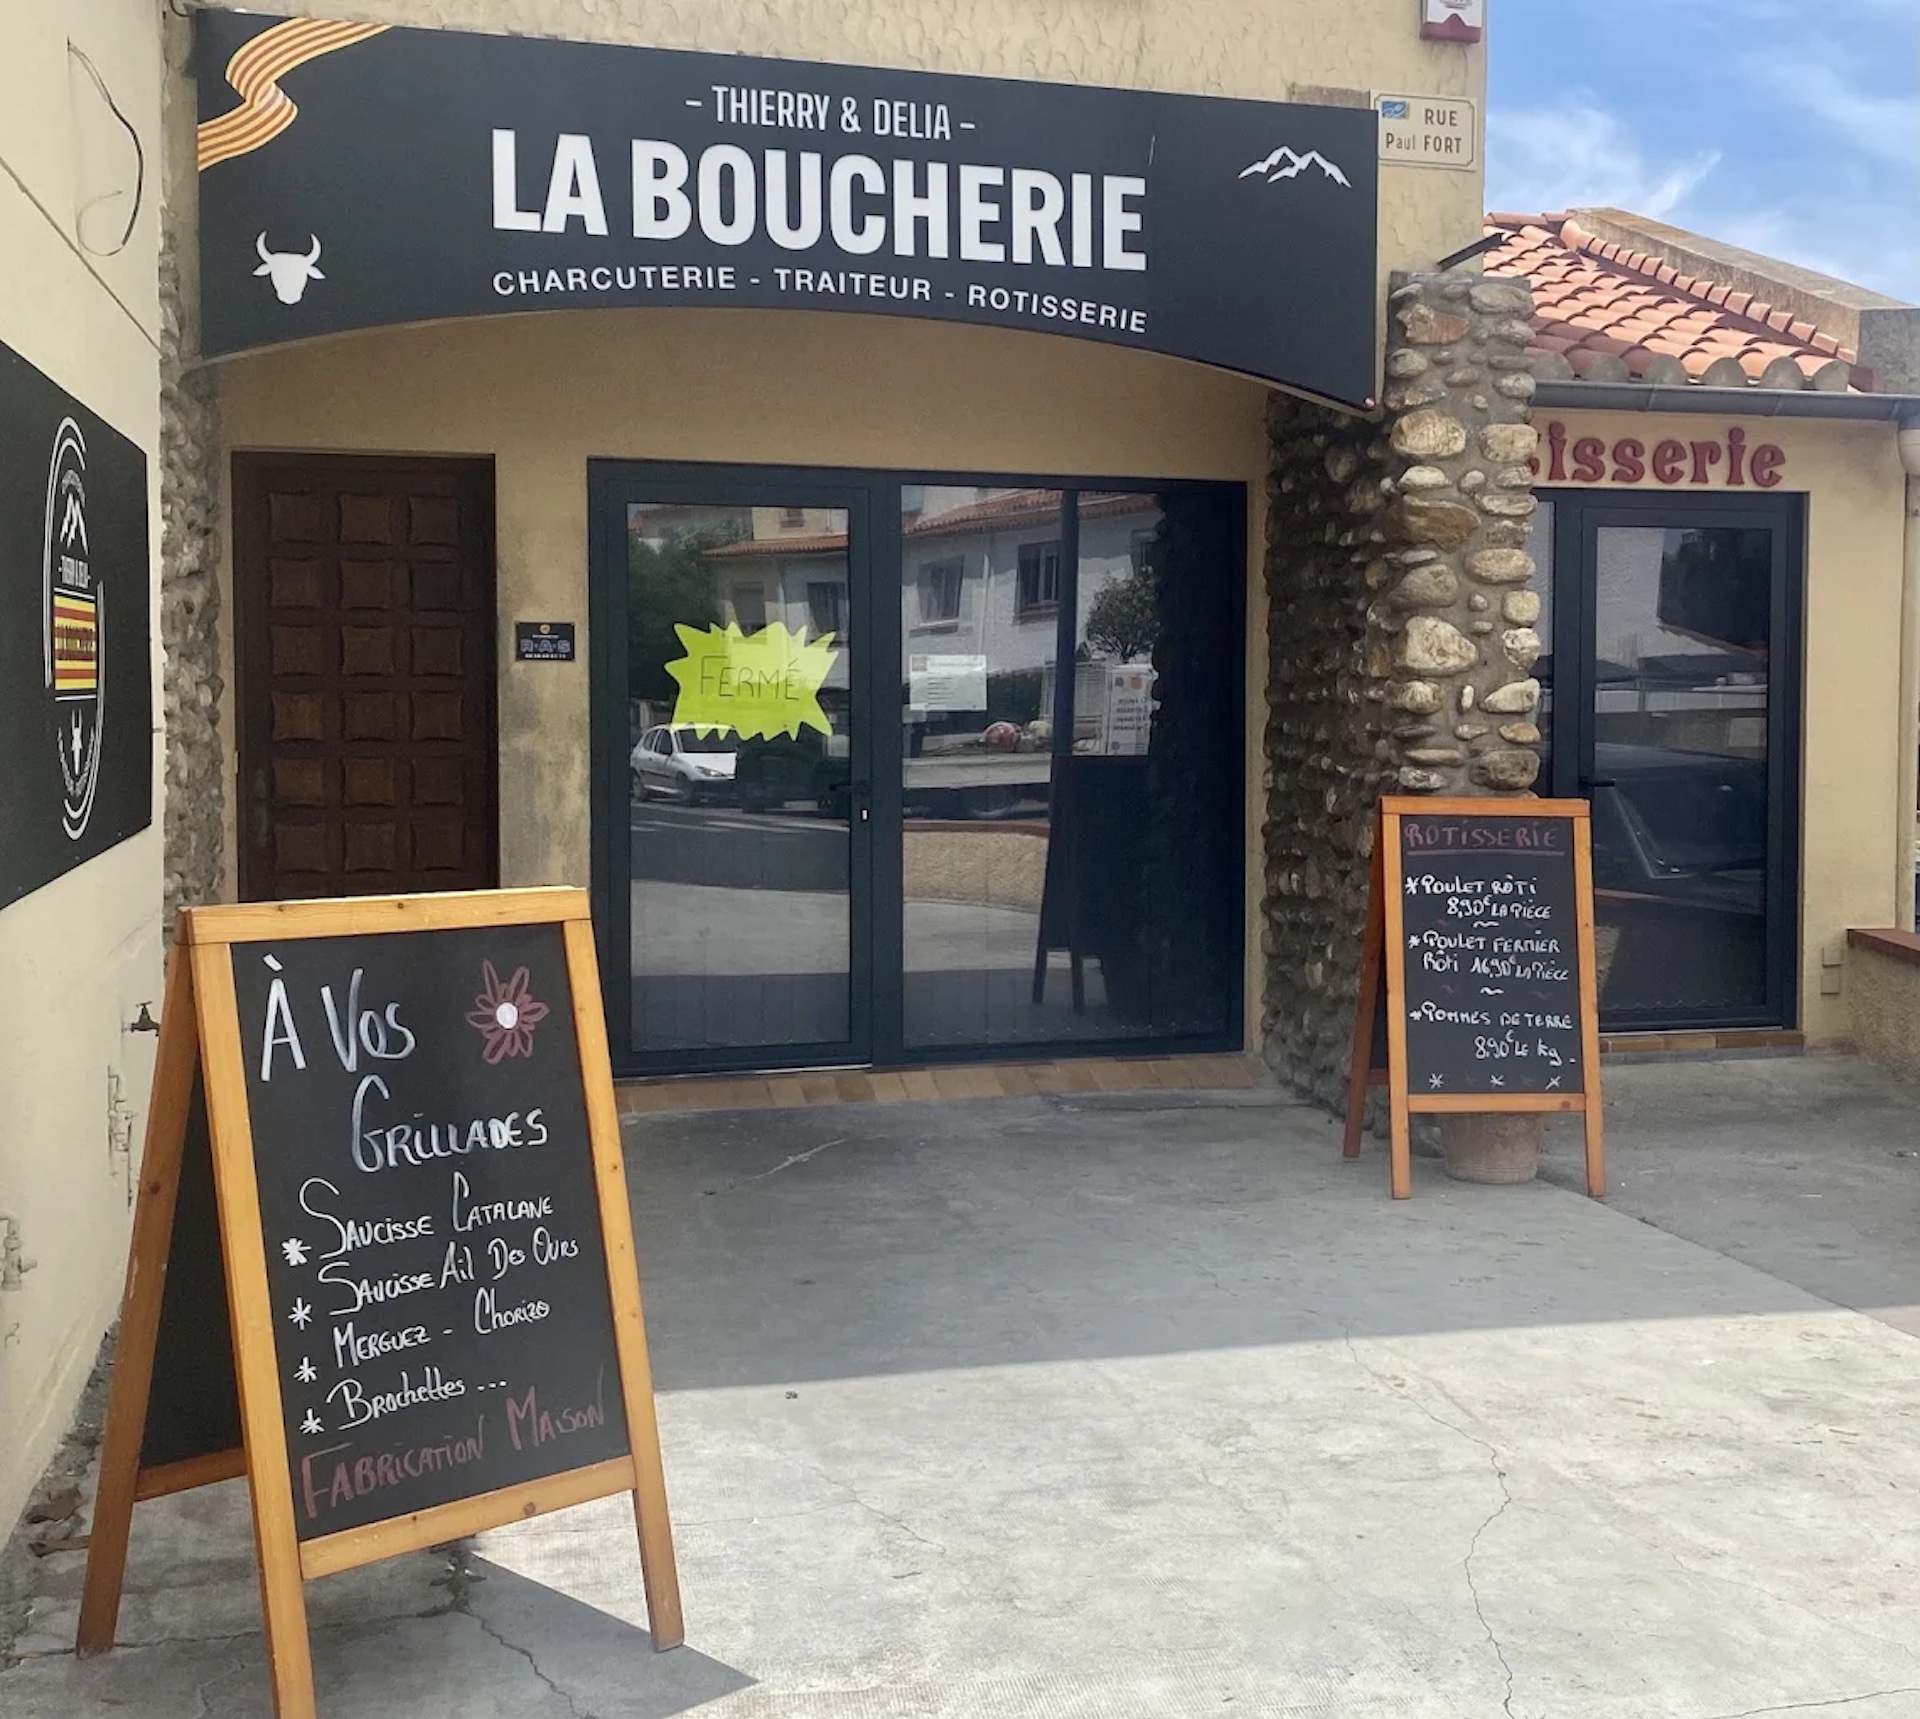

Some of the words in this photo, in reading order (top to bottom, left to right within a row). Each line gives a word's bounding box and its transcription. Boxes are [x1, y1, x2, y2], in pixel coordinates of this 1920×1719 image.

[710, 85, 830, 131] THIERRY
[840, 96, 862, 133] &
[873, 98, 951, 141] DELIA
[1424, 108, 1458, 127] RUE
[1386, 132, 1416, 150] Paul
[1423, 134, 1462, 154] FORT
[491, 128, 609, 236] LA
[630, 138, 1148, 271] BOUCHERIE
[493, 266, 736, 296] CHARCUTERIE
[774, 268, 931, 301] TRAITEUR
[967, 285, 1148, 334] ROTISSERIE
[1526, 421, 1786, 488] isserie
[700, 655, 801, 701] FERMÉ
[261, 953, 307, 1082] À
[1500, 1012, 1520, 1027] DE
